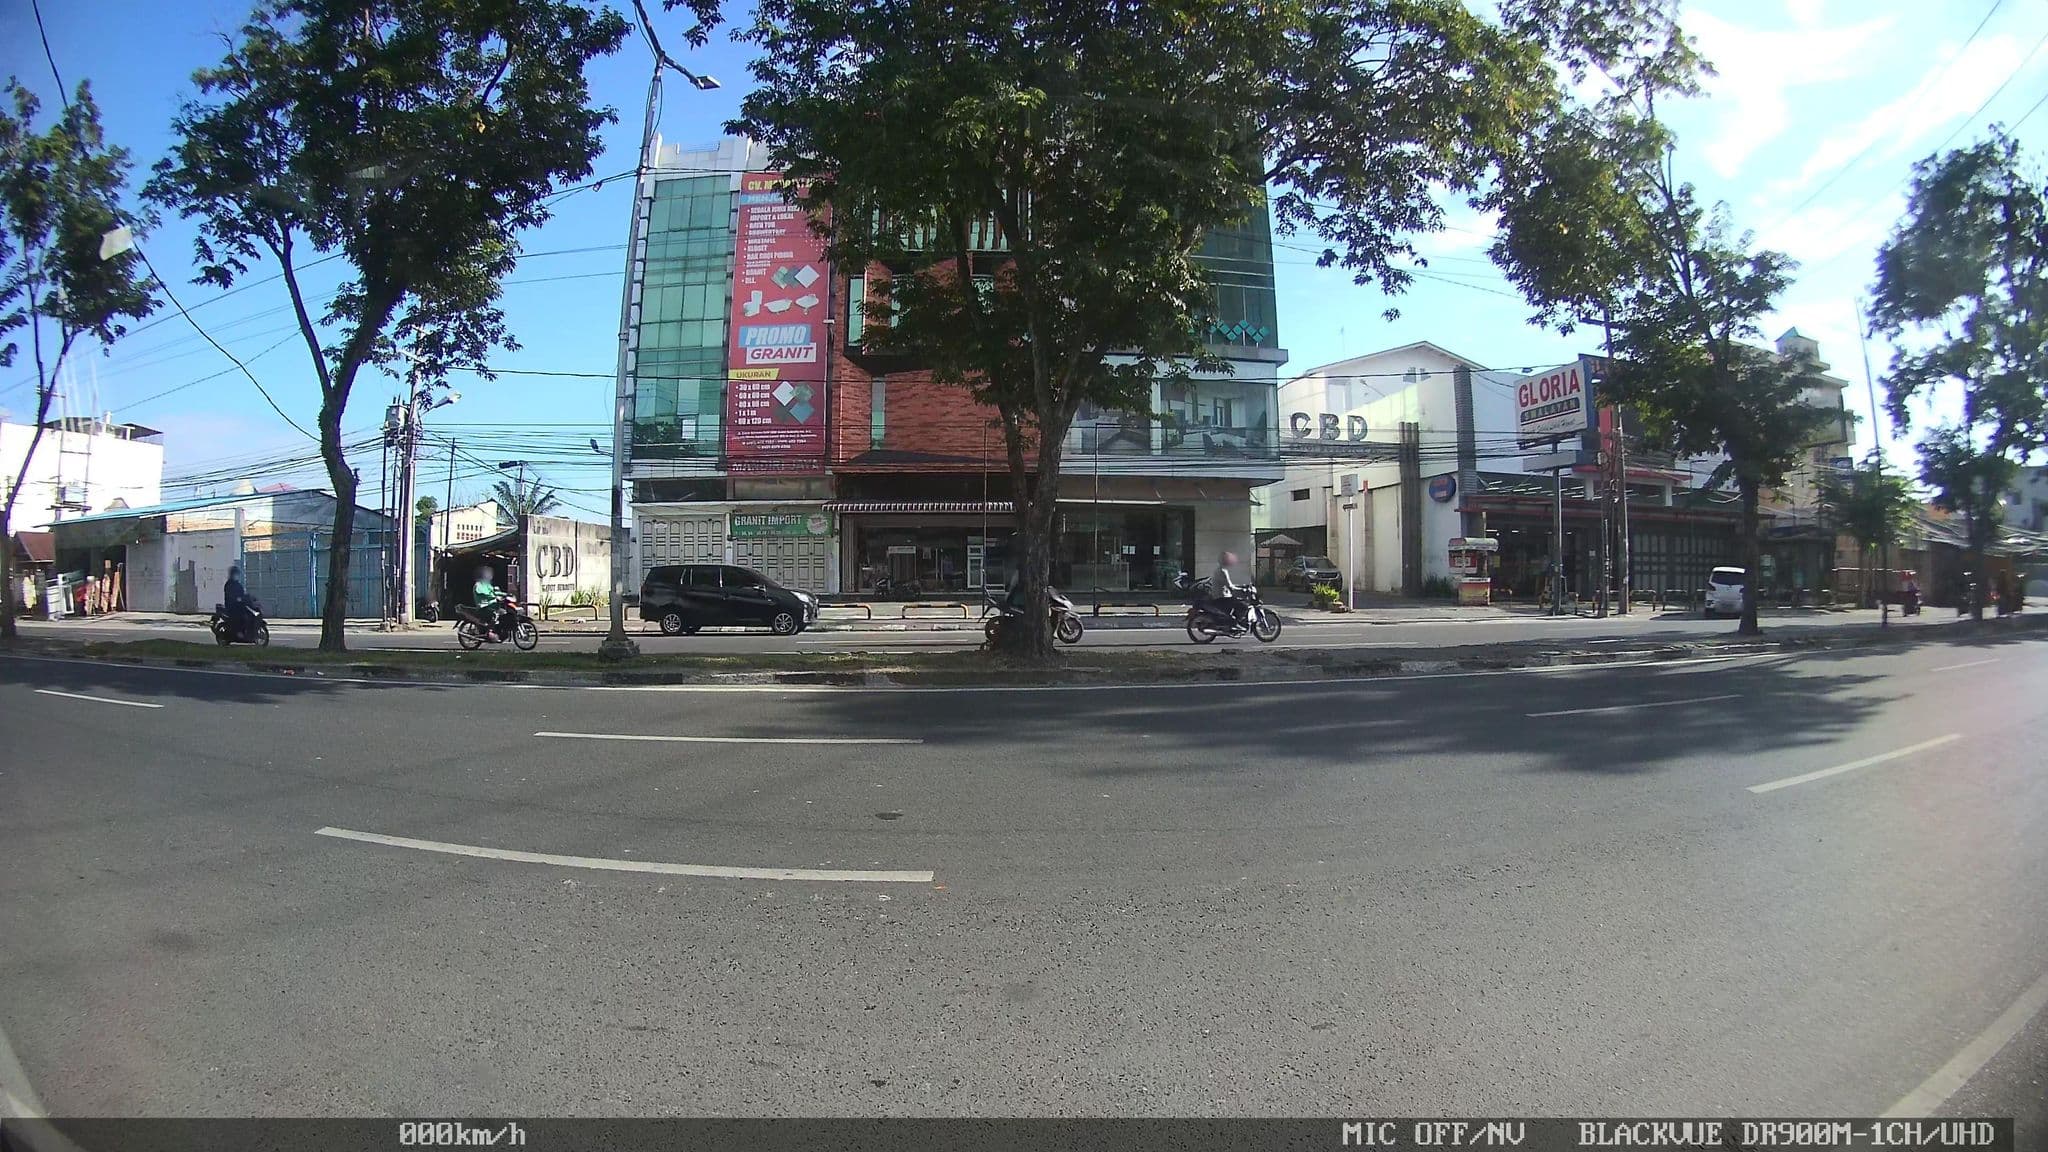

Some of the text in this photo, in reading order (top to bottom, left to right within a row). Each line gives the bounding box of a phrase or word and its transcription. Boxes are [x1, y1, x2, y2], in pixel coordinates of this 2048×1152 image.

[745, 326, 807, 346] PROMO
[750, 347, 814, 360] GRANIT
[736, 371, 771, 379] UKURAN
[1519, 368, 1581, 408] GLORIA
[1289, 412, 1368, 441] CBD
[734, 516, 766, 526] GRANIT
[768, 514, 802, 525] IMPORT
[534, 544, 574, 579] CBD
